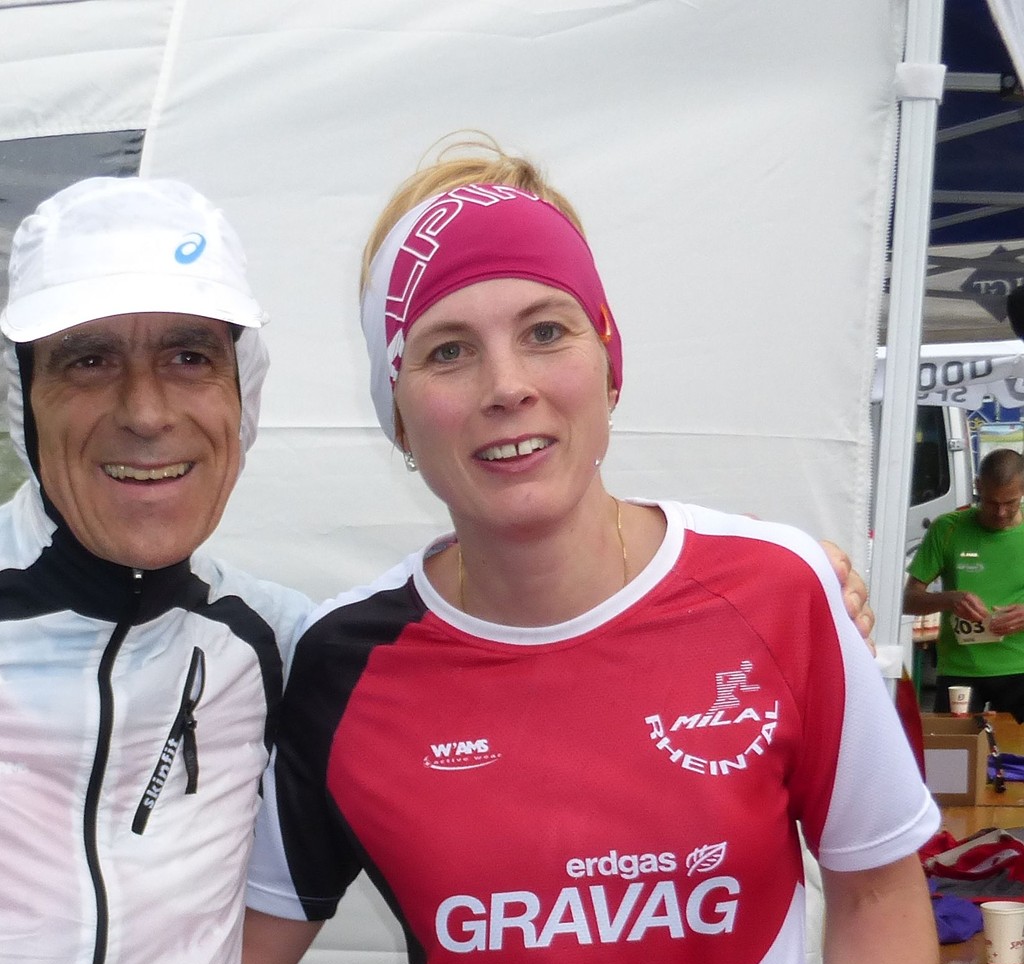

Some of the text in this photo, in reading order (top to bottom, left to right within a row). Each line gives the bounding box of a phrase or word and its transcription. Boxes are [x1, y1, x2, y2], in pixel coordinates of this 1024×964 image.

[144, 738, 178, 810] skinfit
[644, 700, 779, 775] RHEINTAL
[566, 849, 677, 879] erdgas
[435, 875, 741, 953] GRAVAG
